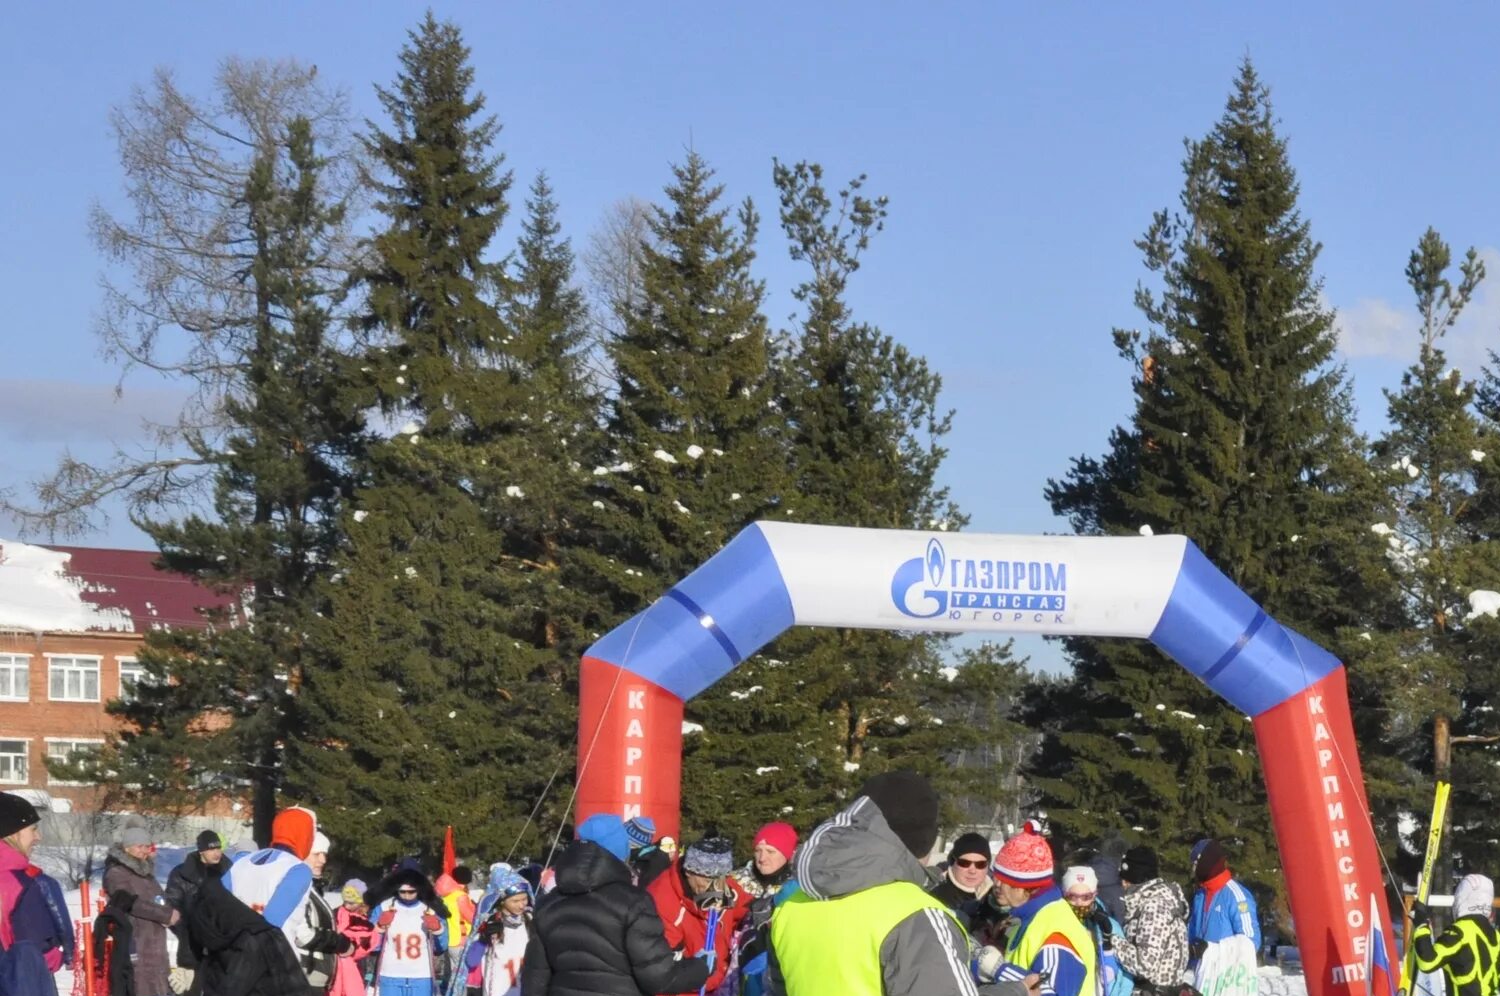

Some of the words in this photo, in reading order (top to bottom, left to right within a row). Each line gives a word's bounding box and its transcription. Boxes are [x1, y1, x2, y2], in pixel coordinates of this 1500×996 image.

[950, 558, 1067, 592] ГАЗПРОМ
[953, 593, 1064, 610] ТРАНСГАЗ
[949, 610, 1064, 623] ЮГОРСК
[1308, 694, 1367, 956] КАРПИНСКОЕ
[392, 933, 421, 960] 18
[504, 956, 525, 988] 1
